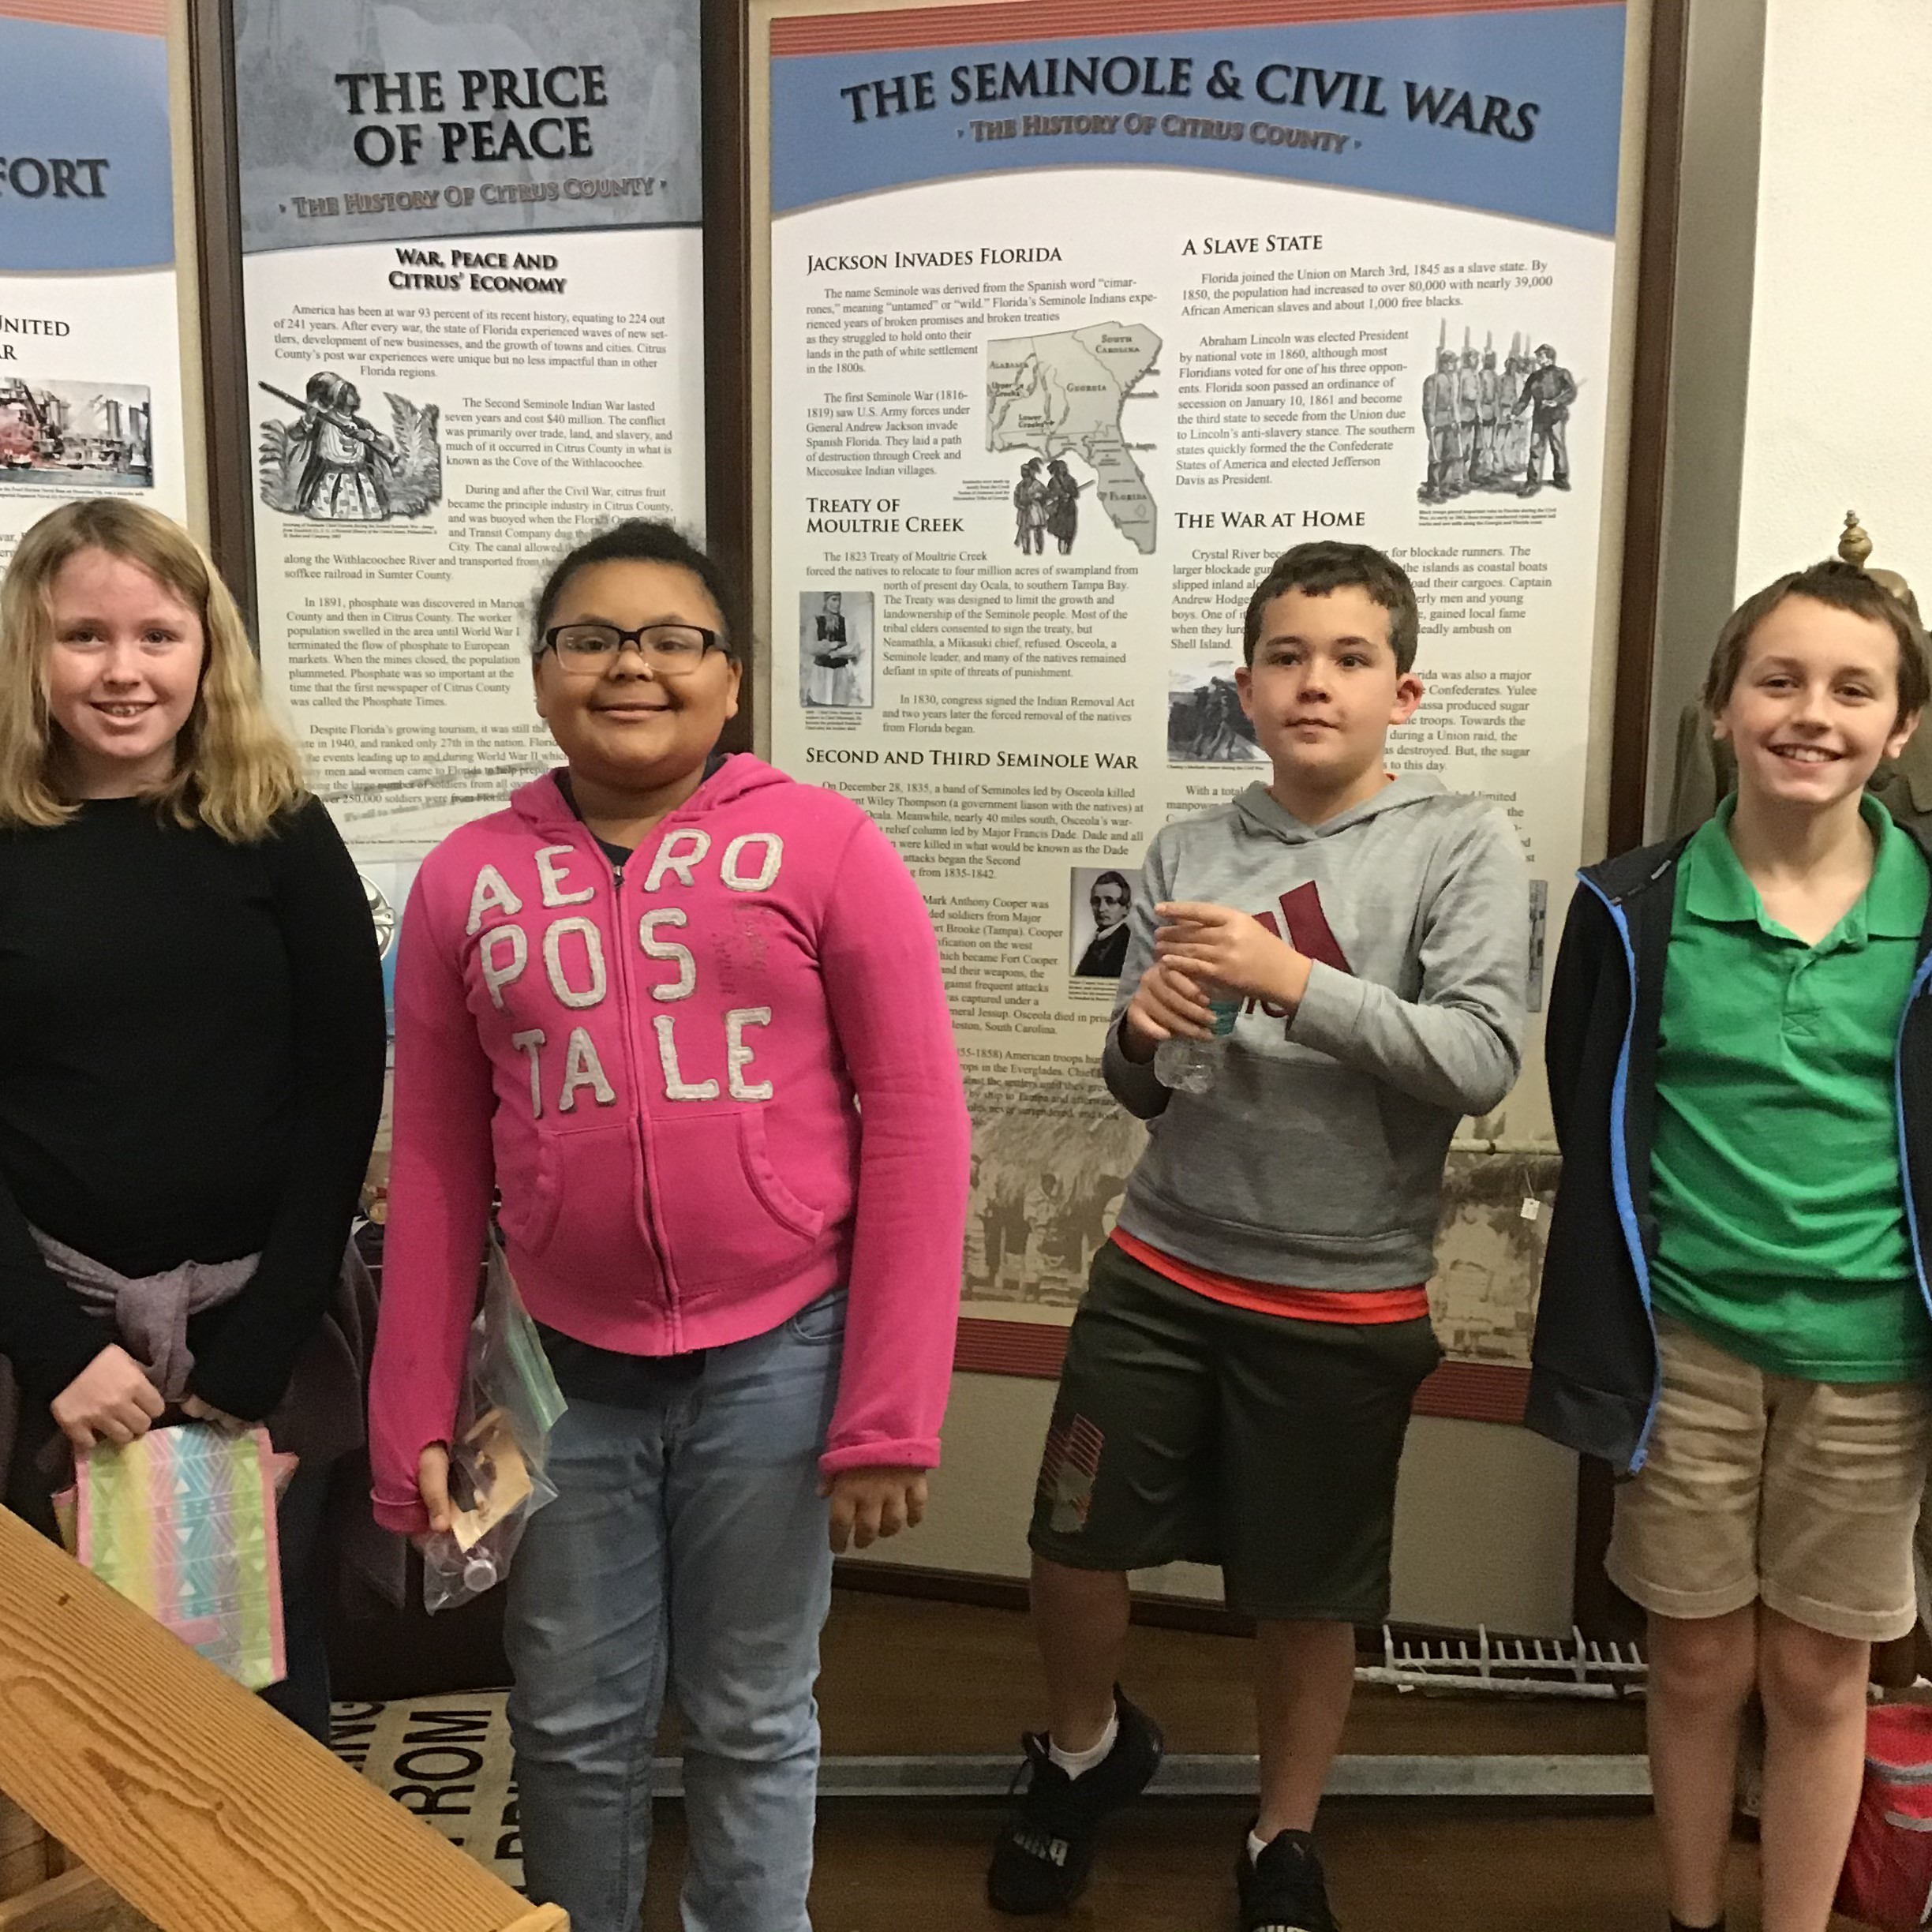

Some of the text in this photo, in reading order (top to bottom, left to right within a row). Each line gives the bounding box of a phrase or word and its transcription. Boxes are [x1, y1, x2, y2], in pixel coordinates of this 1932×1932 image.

[335, 64, 608, 114] THE PRICE
[840, 55, 1541, 144] THE SEMINOLE & CIVIL WARS
[354, 115, 594, 167] OF PEACE
[968, 112, 1350, 155] THE HISTORY OF CITRUS COUNTY
[291, 176, 657, 218] THE HISTORY OF CITRUS COUNTY
[1181, 234, 1323, 256] A SLAVE STATE
[451, 249, 509, 270] PEACE
[512, 252, 559, 271] AND
[807, 247, 1063, 276] JACKSON INVADES FLORIDA
[1201, 271, 1239, 285] Florida
[1240, 270, 1275, 286] joined
[1277, 269, 1294, 281] the
[1297, 268, 1331, 280] Union
[1333, 270, 1347, 279] on
[1350, 265, 1385, 279] March
[1414, 263, 1440, 275] 1845
[1443, 265, 1455, 275] as
[1458, 265, 1465, 274] a
[1467, 262, 1496, 274] slave
[1531, 259, 1548, 273] By
[470, 273, 567, 294] ECONOMY
[823, 288, 843, 299] The
[844, 290, 871, 298] name
[873, 285, 919, 298] Seminole
[921, 286, 941, 295] was
[942, 283, 980, 295] derived
[983, 282, 1007, 294] from
[1009, 281, 1025, 292] the
[1027, 279, 1067, 294] Spanish
[1069, 278, 1096, 290] word
[1213, 288, 1230, 300] the
[1232, 286, 1289, 301] population
[1291, 284, 1311, 297] had
[1314, 282, 1365, 295] increased
[1367, 283, 1379, 294] to
[1380, 283, 1406, 293] over
[1408, 279, 1447, 293] 80,000
[1449, 278, 1473, 290] with
[1476, 277, 1511, 291] nearly
[1515, 275, 1553, 289] 39,000
[292, 304, 336, 316] America
[338, 305, 356, 316] has
[358, 305, 383, 317] been
[384, 308, 395, 317] at
[396, 309, 416, 318] war
[417, 307, 431, 318] 93
[433, 310, 470, 321] percent
[473, 309, 485, 320] of
[486, 311, 499, 320] its
[500, 312, 531, 321] recent
[571, 313, 615, 326] equating
[616, 314, 627, 324] to
[628, 313, 647, 324] 224
[649, 316, 665, 324] out
[1181, 305, 1221, 316] African
[1222, 304, 1275, 315] American
[1277, 301, 1310, 313] slaves
[1312, 299, 1332, 312] and
[1334, 299, 1365, 311] about
[1369, 297, 1399, 310] 1,000
[1401, 296, 1423, 309] free
[462, 397, 656, 411] The Second Seminole Indian War lasted
[1175, 474, 1206, 486] Davis
[1208, 477, 1220, 485] as
[806, 497, 900, 513] TREATY OF
[806, 516, 965, 534] MOULTRIE CREEK
[1174, 510, 1365, 529] THE WAR AT HOME
[822, 550, 987, 564] The 1823 Treaty of Moultrie Creek
[1391, 546, 1408, 558] for
[1410, 546, 1459, 558] blockade
[1509, 545, 1531, 556] The
[305, 597, 316, 608] In
[348, 597, 399, 610] phosphate
[400, 600, 421, 608] was
[422, 597, 476, 608] discovered
[477, 598, 486, 608] in
[1170, 638, 1196, 650] Shell
[900, 694, 910, 704] In
[941, 697, 983, 708] congress
[985, 695, 1017, 708] signed
[1019, 695, 1035, 706] the
[1037, 695, 1068, 707] Indian
[1070, 696, 1115, 707] Removal
[1116, 697, 1135, 707] Act
[806, 747, 1139, 769] SECOND AND THIRD SEMINOLE WAR
[949, 896, 990, 909] Anthony
[992, 897, 1028, 911] Cooper
[389, 1710, 492, 1846] ROM
